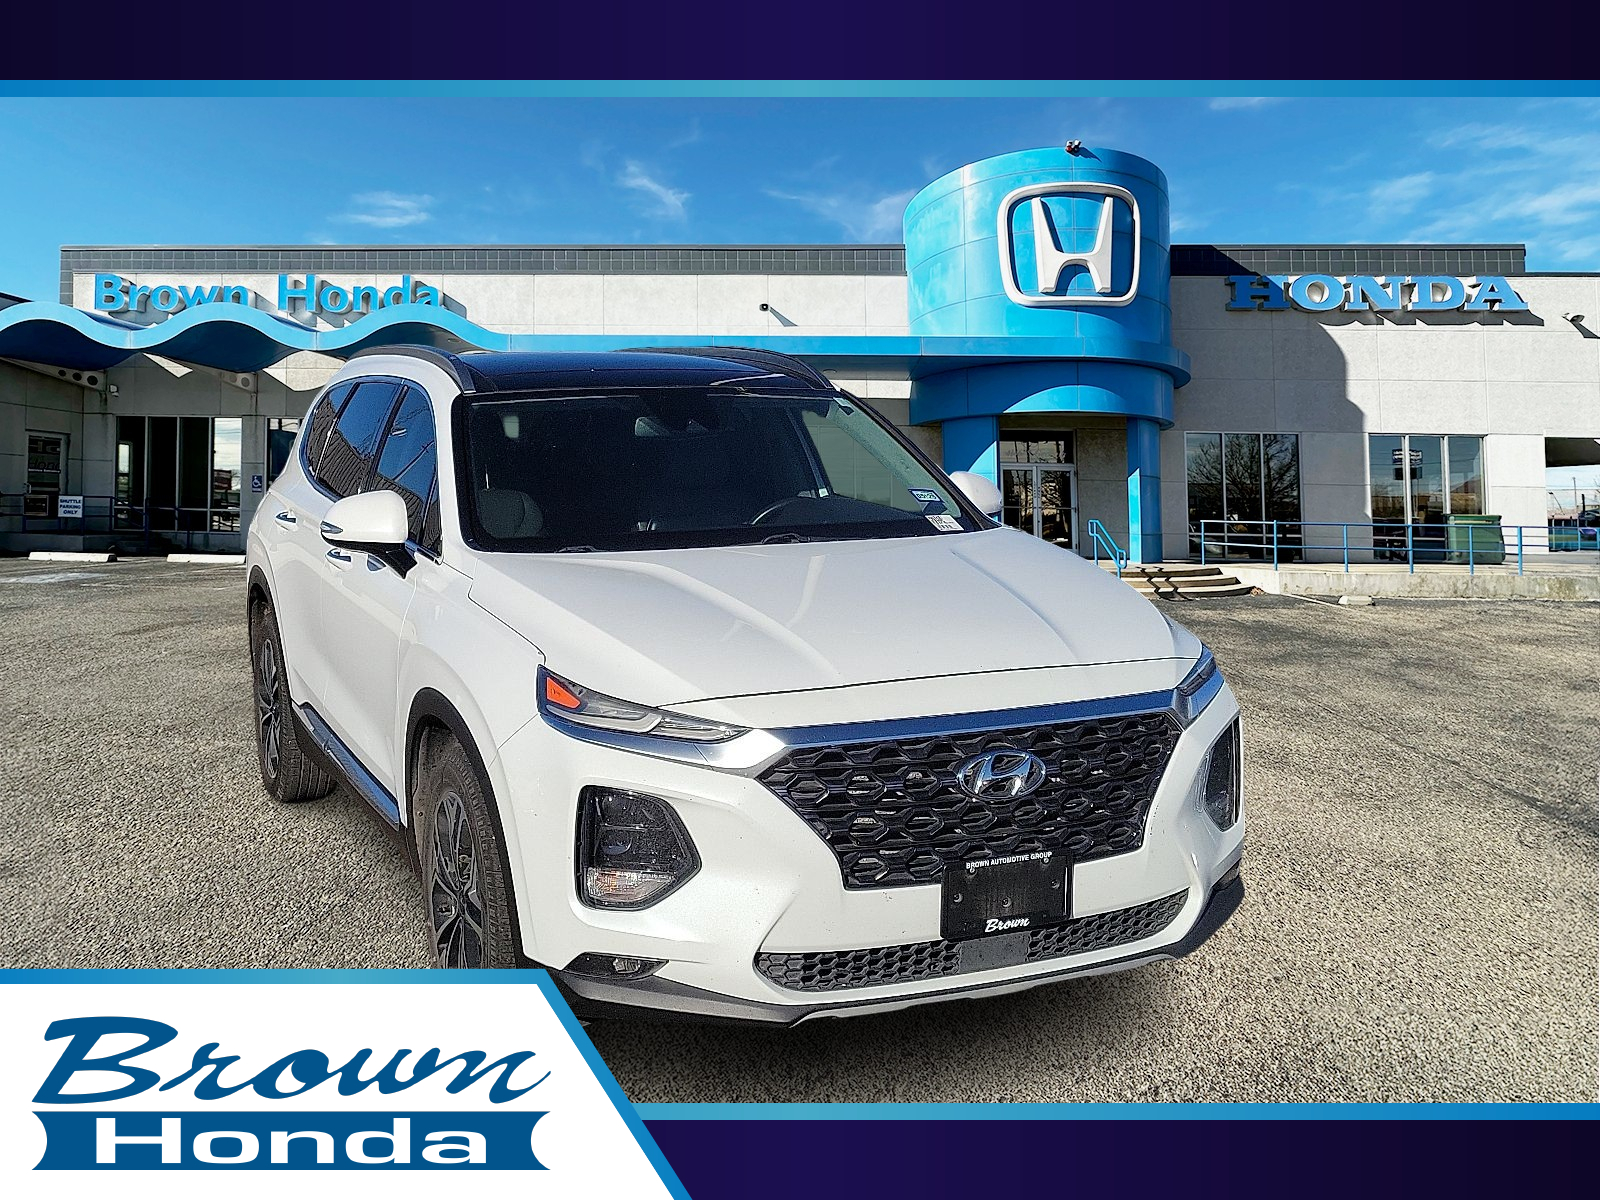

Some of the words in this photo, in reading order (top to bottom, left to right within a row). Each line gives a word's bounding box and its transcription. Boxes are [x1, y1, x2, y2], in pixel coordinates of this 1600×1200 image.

[94, 274, 249, 312] Brown
[278, 274, 440, 312] Honda
[1228, 274, 1529, 311] HONDA
[966, 860, 990, 870] BROWN
[990, 854, 1030, 866] AUTOMOTIVE
[1030, 852, 1053, 860] GROUP
[985, 918, 1030, 933] Brown
